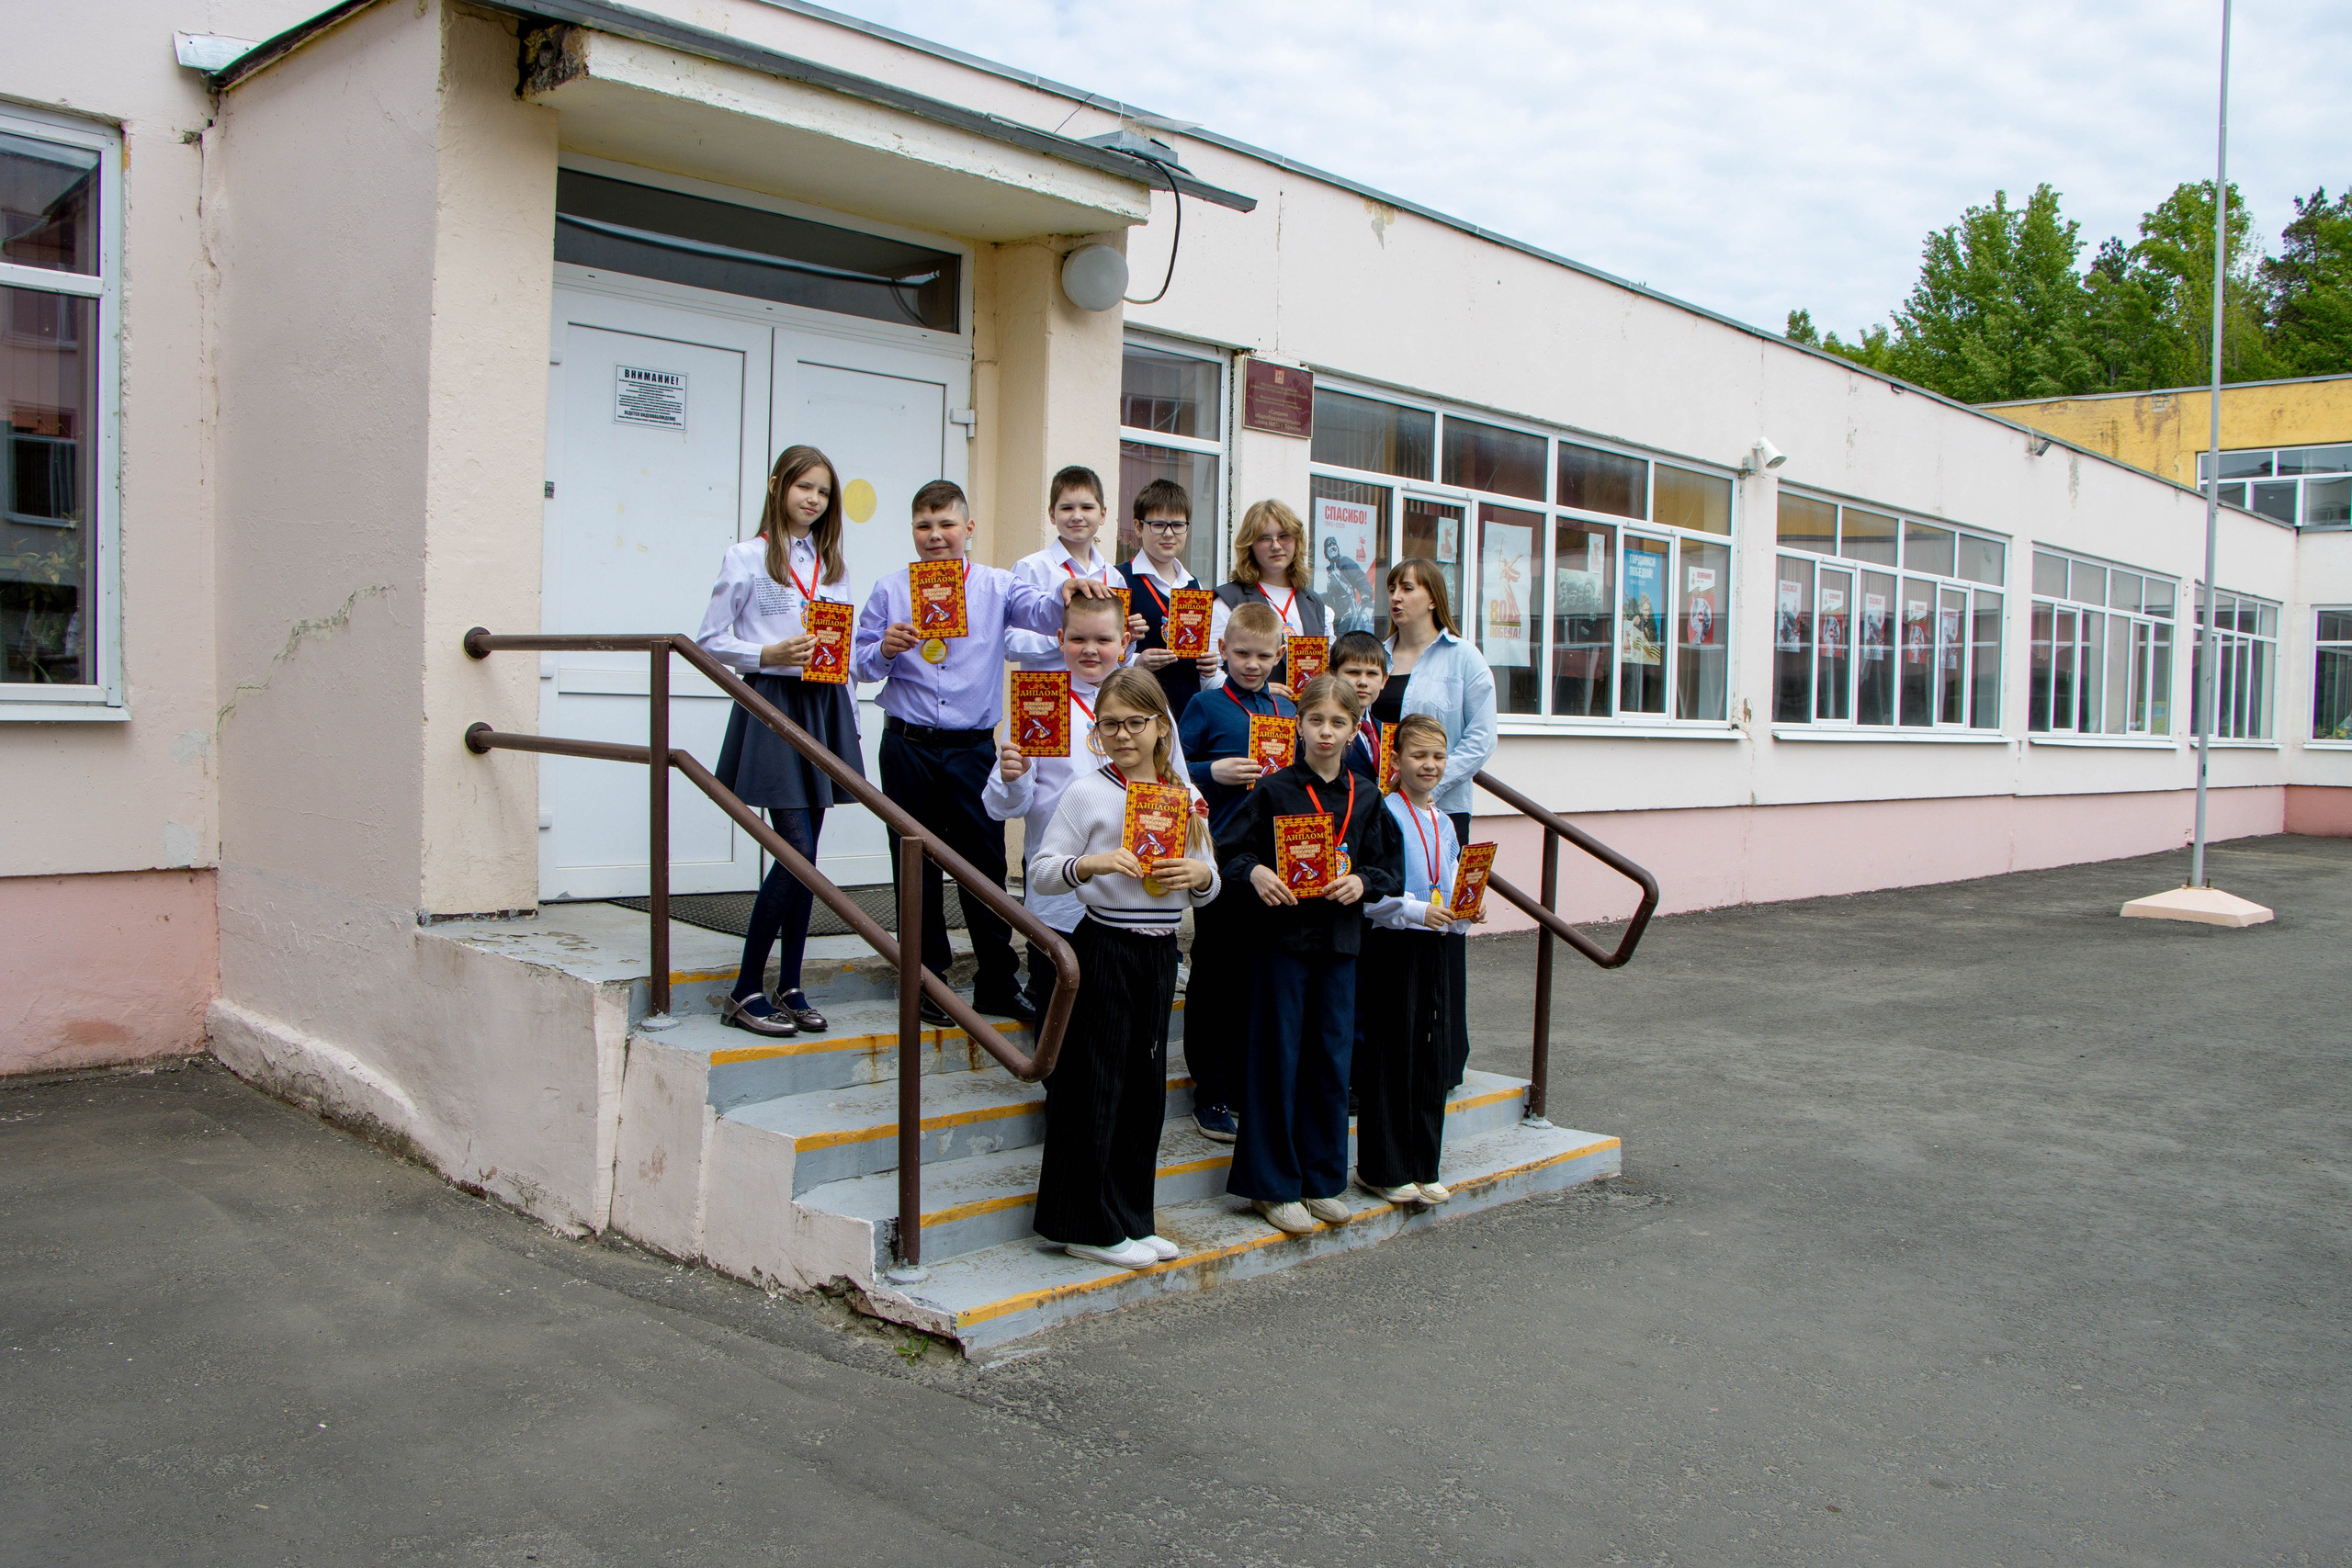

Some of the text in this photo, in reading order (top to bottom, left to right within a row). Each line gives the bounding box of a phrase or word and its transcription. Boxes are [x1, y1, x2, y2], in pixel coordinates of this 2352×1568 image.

[625, 368, 679, 386] ВНИМАНИЕ!
[1324, 505, 1367, 525] СПАСИБО!
[919, 576, 955, 585] ДИПЛОМ
[1489, 599, 1508, 623] 80
[815, 618, 845, 627] ДИПЛОМ
[1489, 626, 1521, 640] ПОБЕДА!
[1259, 731, 1289, 739] ДИПЛОМ
[1136, 801, 1178, 813] ДИПЛОМ
[1285, 832, 1324, 842] ДИПЛОМ
